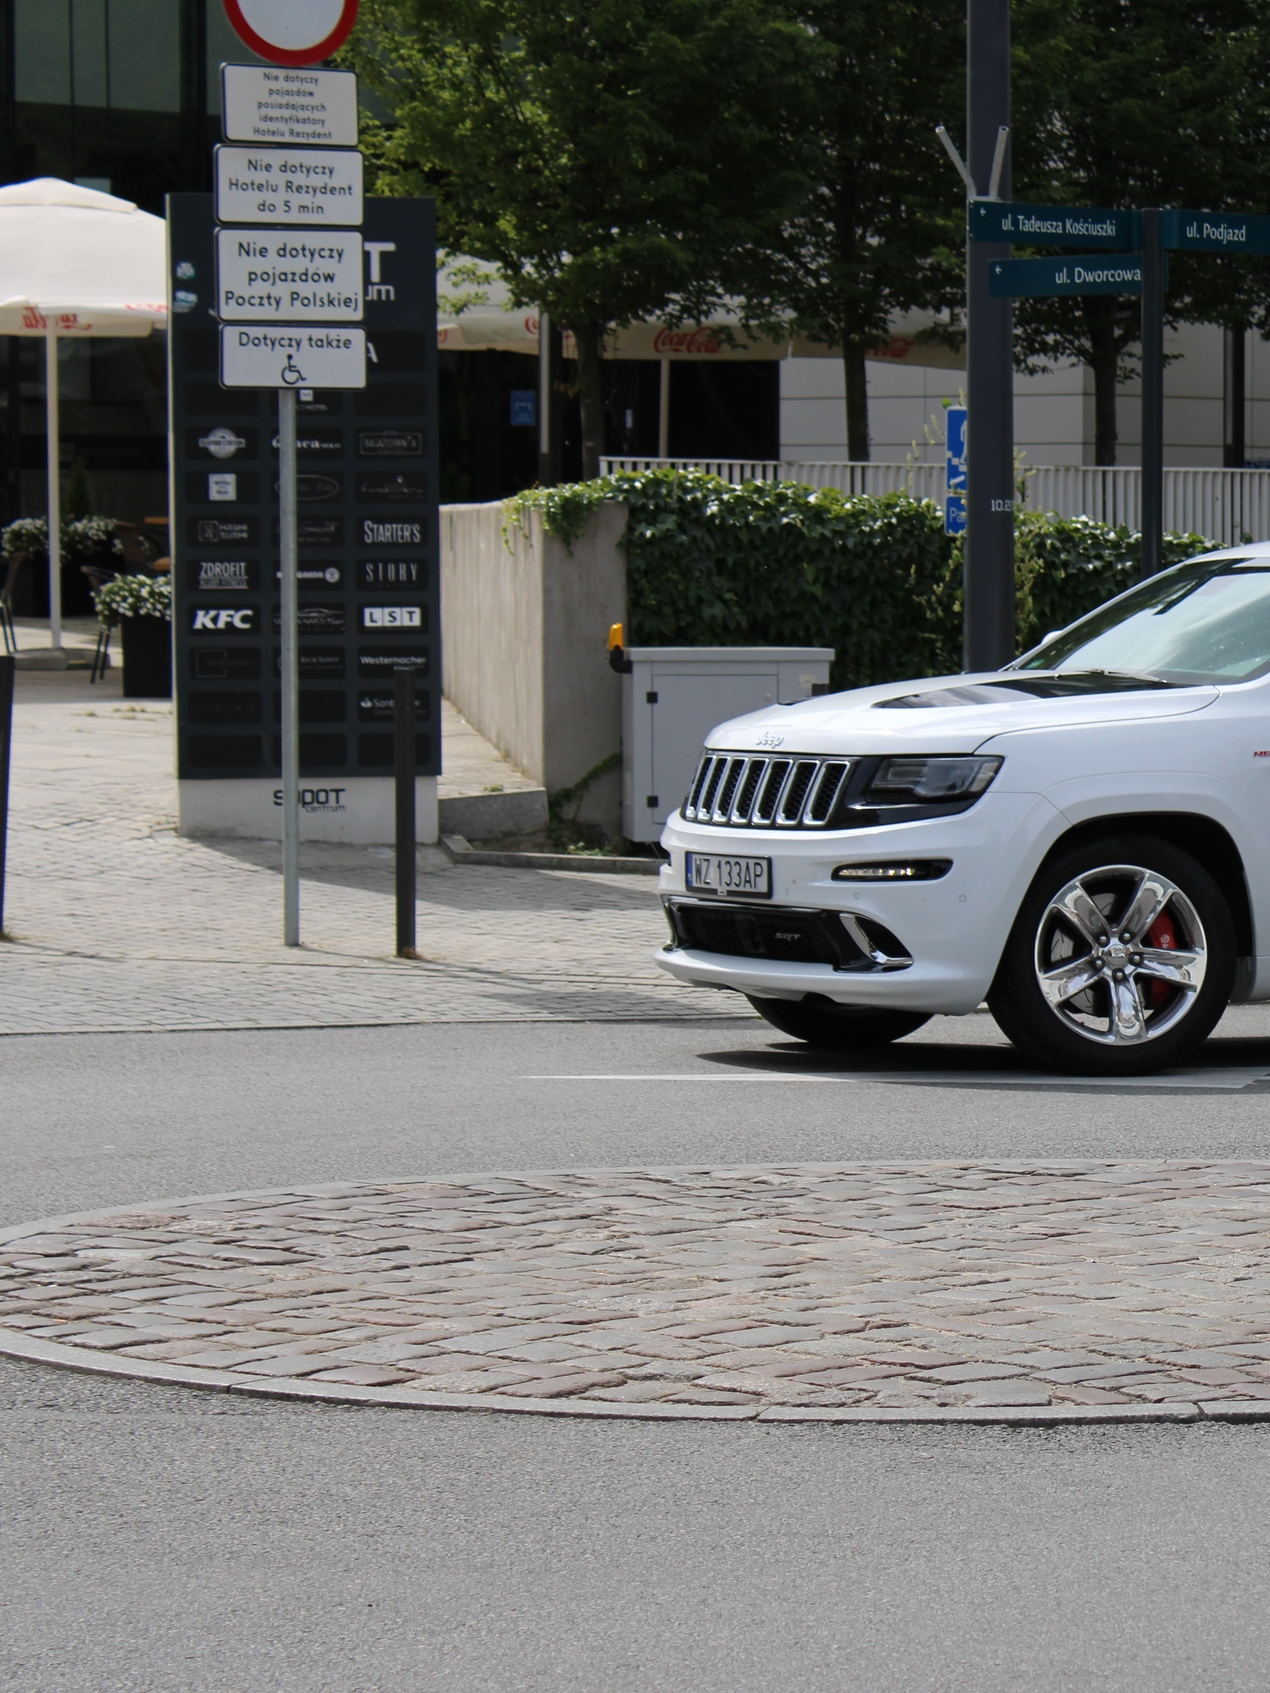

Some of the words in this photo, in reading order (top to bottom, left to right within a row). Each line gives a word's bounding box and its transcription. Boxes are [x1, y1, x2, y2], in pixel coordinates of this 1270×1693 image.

[263, 72, 279, 81] Nie
[283, 73, 318, 86] dotyczy
[268, 87, 315, 98] pojazdów
[257, 101, 326, 112] posiadających
[259, 113, 325, 126] identyfikatory
[253, 127, 285, 137] Hotelu
[289, 128, 332, 140] Rezydent
[248, 159, 272, 172] Nie
[279, 161, 334, 178] dotyczy
[228, 178, 278, 193] Hotelu
[285, 180, 353, 198] Rezydent
[257, 200, 276, 212] do
[283, 200, 291, 213] 5
[298, 202, 324, 214] min
[1001, 218, 1015, 231] ul.
[1017, 215, 1063, 235] Tadeusza
[1066, 217, 1116, 237] Kościuszki
[1186, 223, 1200, 238] ul.
[1203, 223, 1246, 245] Podjazd
[238, 242, 268, 258] Nie
[277, 243, 344, 263] dotyczy
[248, 267, 336, 286] pojazdów
[1055, 269, 1071, 284] ul.
[1074, 267, 1141, 284] Dworcowa
[224, 290, 282, 311] Poczty
[290, 291, 358, 312] Polskiej
[239, 332, 302, 351] Dotyczy
[307, 334, 352, 349] także
[363, 519, 421, 544] STARTER'S
[200, 561, 246, 577] ZDROFIT
[365, 562, 418, 582] STORY
[193, 609, 254, 629] KFC
[359, 655, 427, 665] Westernacher
[755, 731, 785, 749] Jeep
[305, 804, 346, 813] centrum
[694, 857, 711, 886] WZ
[716, 860, 764, 890] 133AP
[774, 932, 801, 942] SRT
